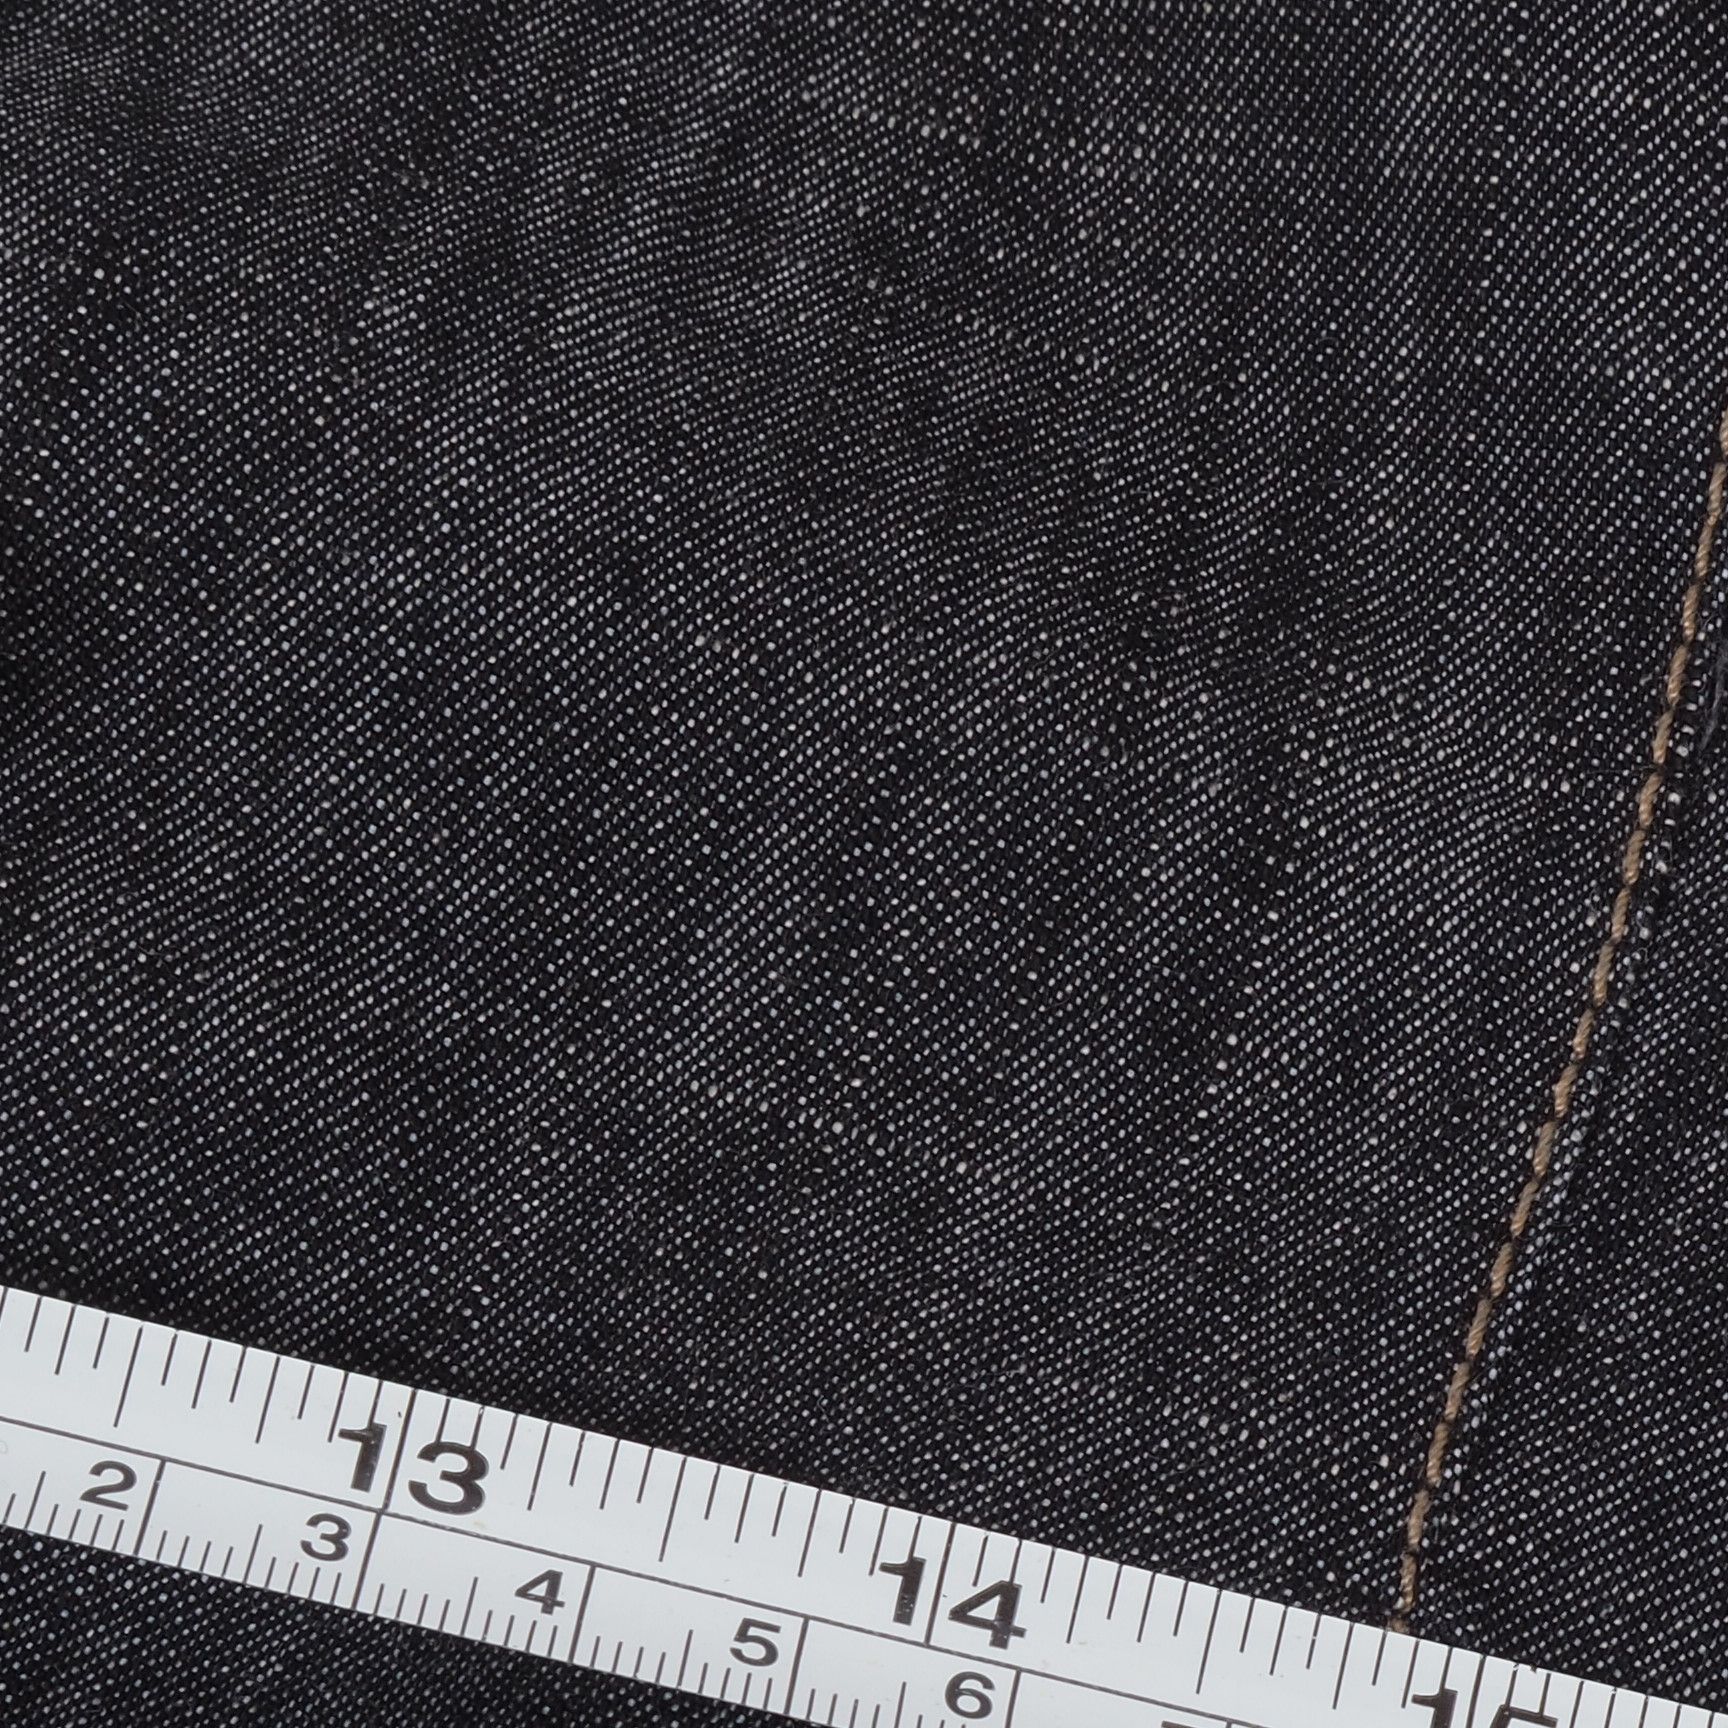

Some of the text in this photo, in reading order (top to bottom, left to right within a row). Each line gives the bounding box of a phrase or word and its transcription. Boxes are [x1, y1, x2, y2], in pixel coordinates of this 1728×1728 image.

[79, 1459, 138, 1511] 2
[300, 1512, 352, 1561] 3
[513, 1569, 566, 1615] 4
[729, 1618, 782, 1668] 5
[944, 1671, 997, 1720] 6
[340, 1421, 489, 1515] 13
[879, 1556, 1027, 1650] 14
